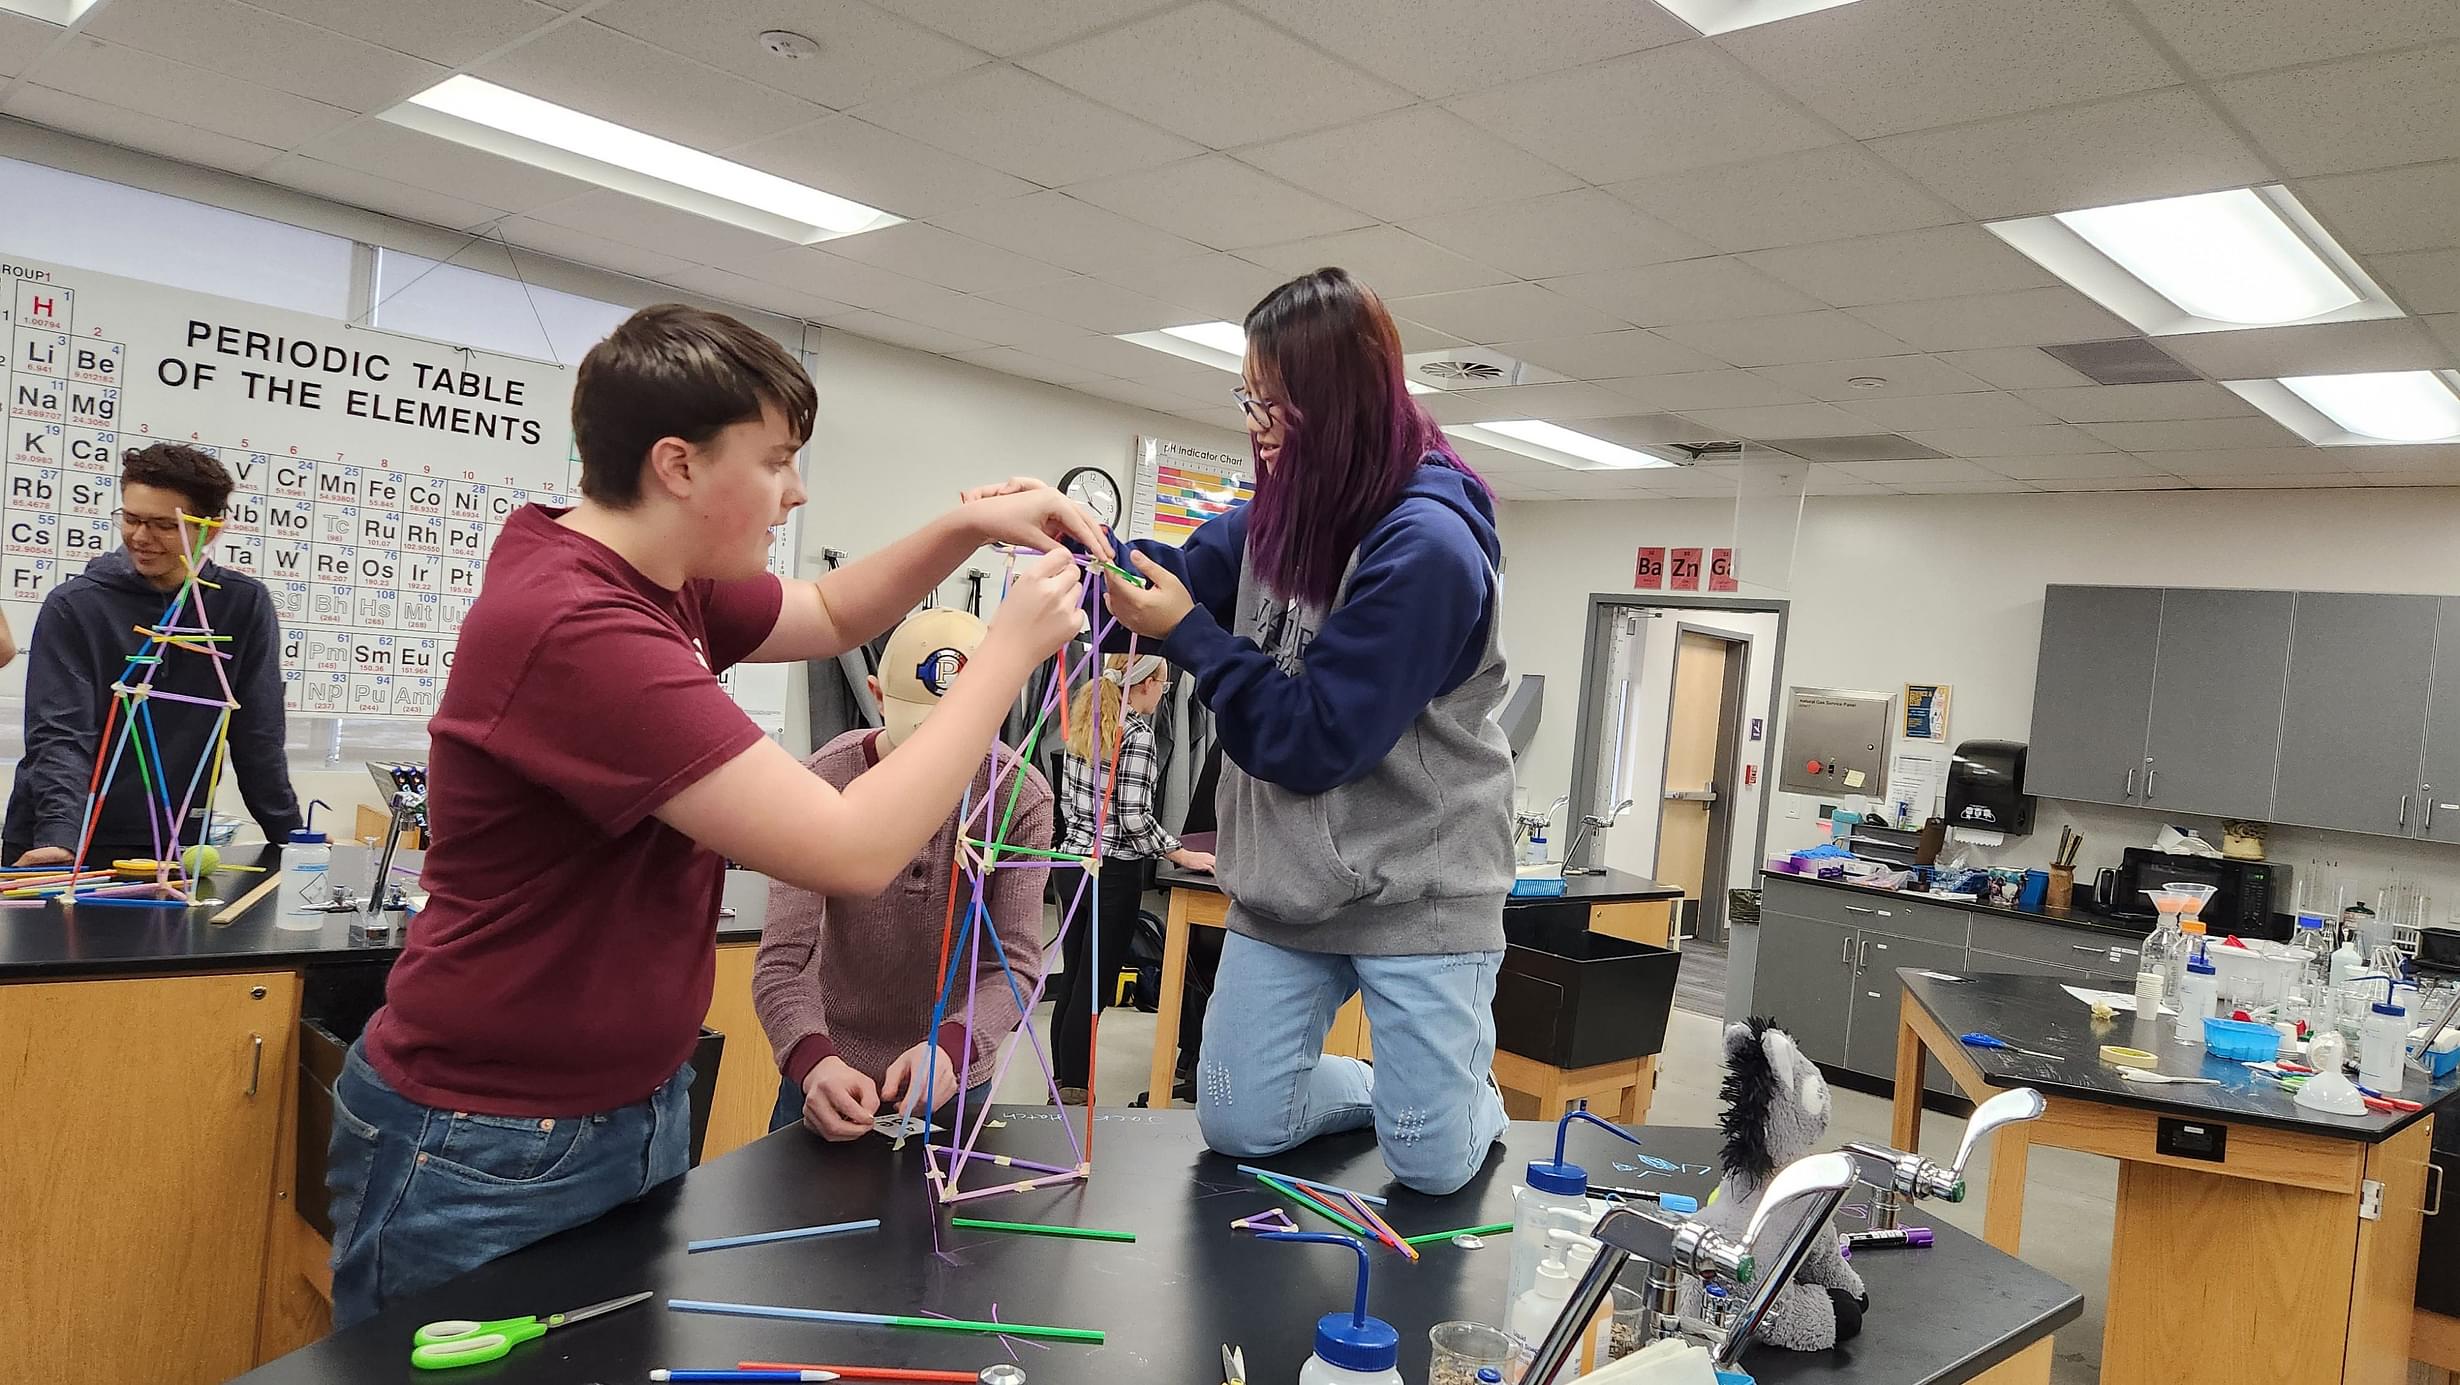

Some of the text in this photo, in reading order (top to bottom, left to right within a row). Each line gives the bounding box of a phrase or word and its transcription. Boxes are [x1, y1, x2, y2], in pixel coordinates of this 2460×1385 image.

[2, 264, 44, 280] ROUP
[64, 291, 70, 301] 1
[33, 295, 54, 317] H
[24, 317, 61, 328] 1.00794
[94, 327, 102, 336] 2
[58, 336, 66, 345] 3
[30, 341, 54, 363] Li
[112, 346, 120, 354] 4
[78, 349, 114, 373] Be
[187, 320, 525, 406] PERIODIC TABLE
[27, 363, 52, 373] 6.941
[52, 381, 64, 391] 11
[19, 386, 57, 410] Na
[102, 389, 117, 399] 12
[72, 394, 114, 419] Mg
[158, 358, 541, 445] OF THE ELEMENTS
[45, 425, 60, 436] 19
[140, 423, 149, 433] 3
[97, 432, 114, 443] 20
[192, 432, 198, 440] 4
[25, 432, 45, 453] K
[242, 439, 249, 448] 5
[71, 439, 109, 462] Ca
[290, 446, 297, 454] 6
[1164, 444, 1242, 466] pH Indicator Chart
[250, 454, 266, 464] 23
[337, 452, 344, 461] 7
[298, 461, 313, 470] 24
[381, 459, 388, 468] 8
[40, 469, 58, 480] 37
[236, 462, 252, 480] V
[345, 467, 359, 477] 25
[424, 465, 430, 474] 9
[277, 468, 307, 488] Cr
[389, 473, 402, 483] 26
[463, 471, 474, 480] 10
[504, 477, 514, 485] 11
[95, 476, 112, 487] 38
[320, 474, 356, 495] Mn
[431, 480, 444, 488] 27
[543, 482, 554, 491] 12
[13, 477, 52, 499] Rb
[369, 480, 396, 499] Fe
[472, 484, 486, 494] 28
[72, 484, 103, 505] Sr
[410, 486, 441, 505] Co
[513, 490, 525, 499] 29
[552, 495, 564, 504] 30
[250, 496, 264, 505] 41
[296, 501, 311, 511] 42
[456, 492, 478, 511] Ni
[224, 504, 258, 524] Nb
[342, 507, 357, 517] 43
[386, 512, 399, 521] 44
[39, 514, 56, 525] 55
[270, 508, 307, 529] Mo
[323, 514, 350, 534] Tc
[428, 518, 442, 527] 45
[92, 520, 109, 531] 56
[365, 519, 395, 539] Ru
[470, 523, 484, 531] 46
[11, 523, 50, 545] Cs
[66, 528, 102, 550] Ba
[407, 525, 437, 544] Rh
[450, 530, 478, 548] Pd
[245, 537, 261, 547] 73
[294, 542, 309, 551] 74
[368, 539, 391, 547] 101.07
[225, 545, 252, 564] Ta
[340, 546, 354, 556] 75
[384, 551, 398, 560] 76
[276, 550, 300, 568] W
[318, 554, 349, 573] Re
[426, 556, 439, 565] 77
[468, 560, 480, 569] 78
[36, 560, 53, 570] 87
[362, 559, 393, 578] Os
[1638, 557, 1661, 575] Ba
[1672, 559, 1698, 577] Zn
[412, 564, 428, 581] Ir
[451, 568, 473, 586] Pt
[14, 568, 43, 589] Fr
[286, 582, 307, 592] 106
[332, 586, 352, 596] 107
[271, 590, 303, 611] Sg
[376, 590, 395, 600] 108
[418, 594, 437, 603] 109
[315, 594, 348, 614] Bh
[360, 598, 391, 617] Hs
[404, 602, 433, 621] Mt
[289, 631, 304, 640] 60
[337, 634, 349, 642] 61
[379, 637, 393, 645] 62
[285, 641, 298, 658] d
[421, 640, 435, 648] 63
[309, 641, 347, 661] Pm
[355, 645, 391, 664] Sm
[401, 648, 430, 666] Eu
[286, 672, 301, 680] 92
[332, 674, 347, 682] 93
[376, 676, 390, 685] 94
[419, 678, 433, 687] 95
[308, 682, 343, 702] Np
[355, 684, 386, 703] Pu
[394, 687, 432, 705] Am
